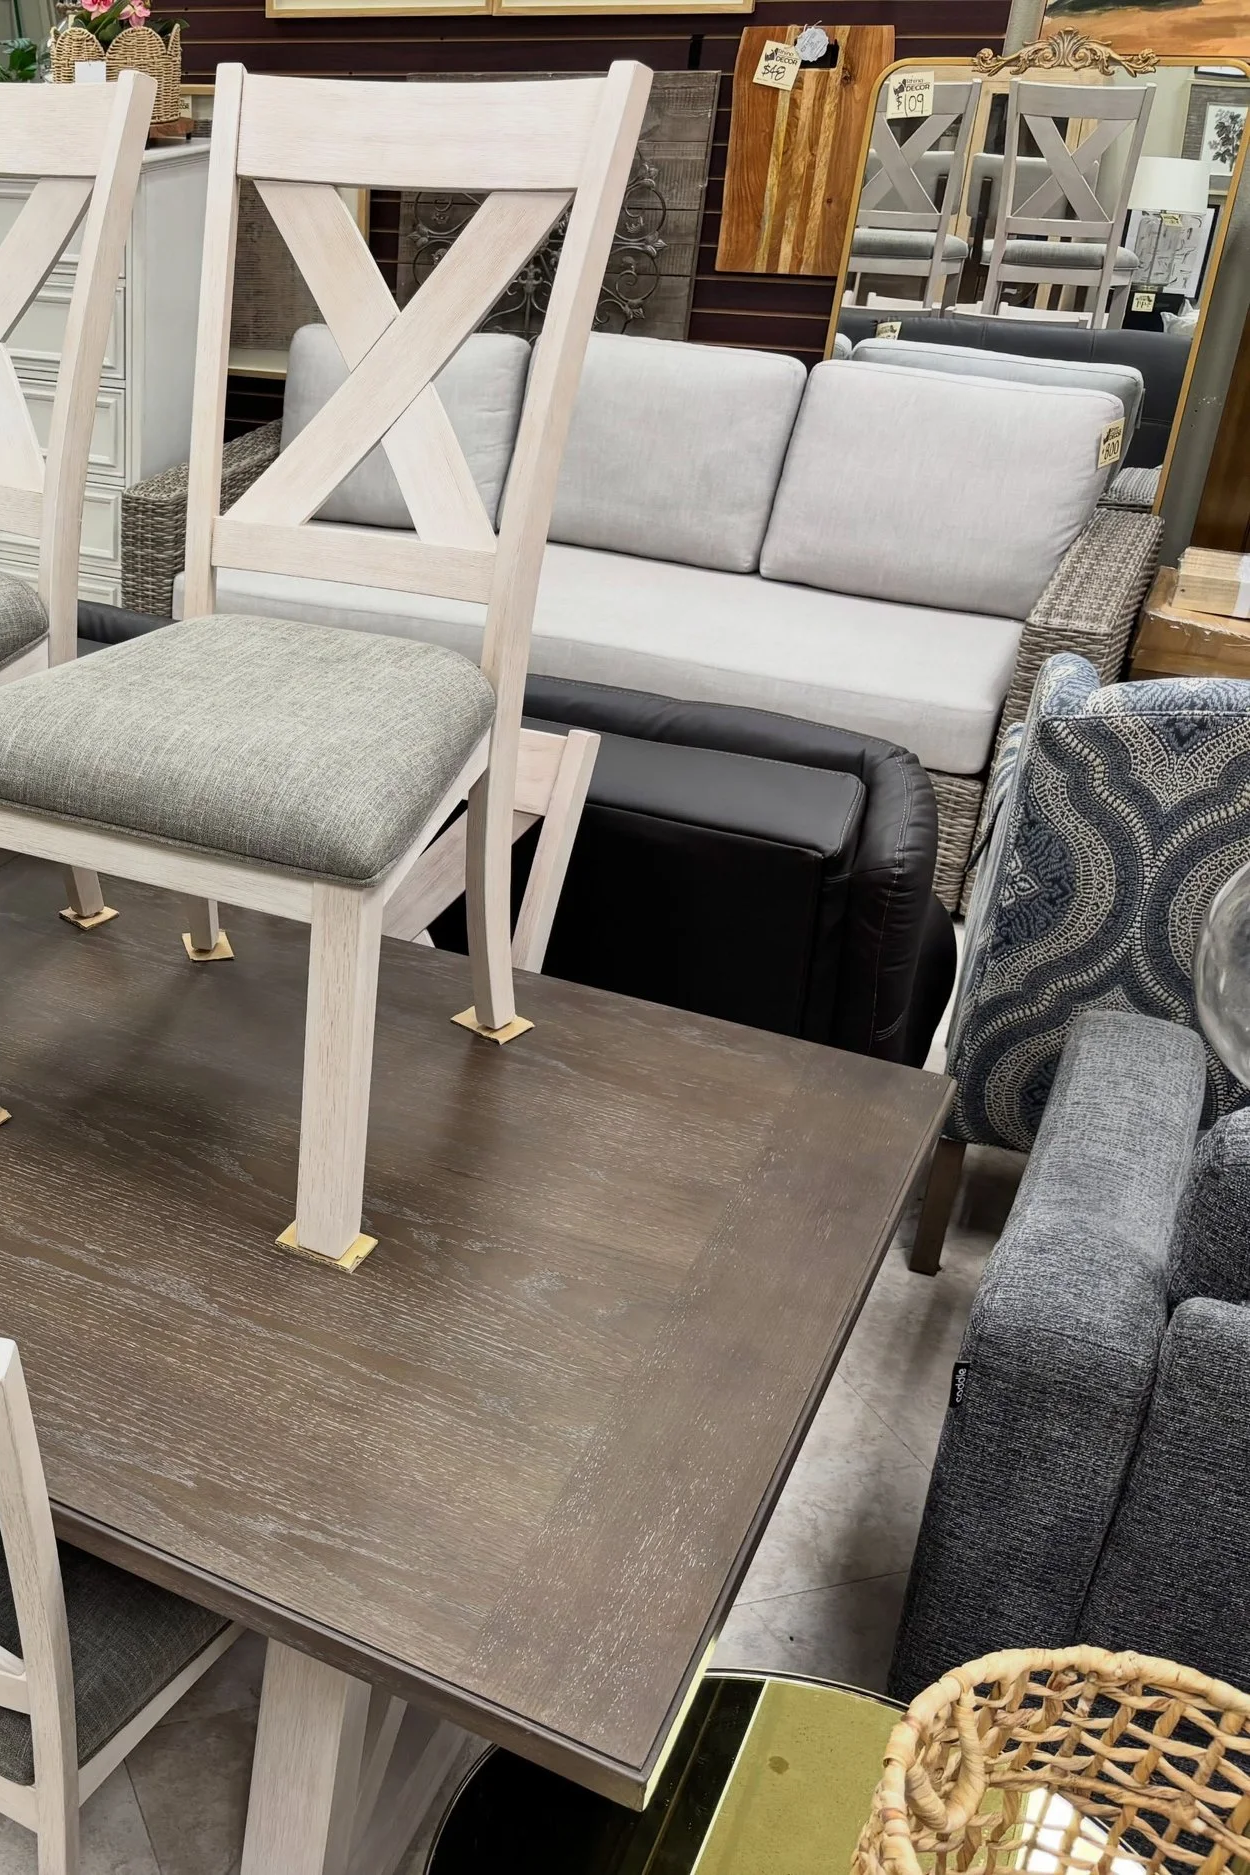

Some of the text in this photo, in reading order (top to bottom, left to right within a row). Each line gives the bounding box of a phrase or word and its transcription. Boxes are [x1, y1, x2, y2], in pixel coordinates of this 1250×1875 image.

[776, 56, 798, 65] DECOR
[906, 84, 930, 92] DECOR
[896, 94, 924, 117] $109
[955, 1368, 967, 1403] coddle
